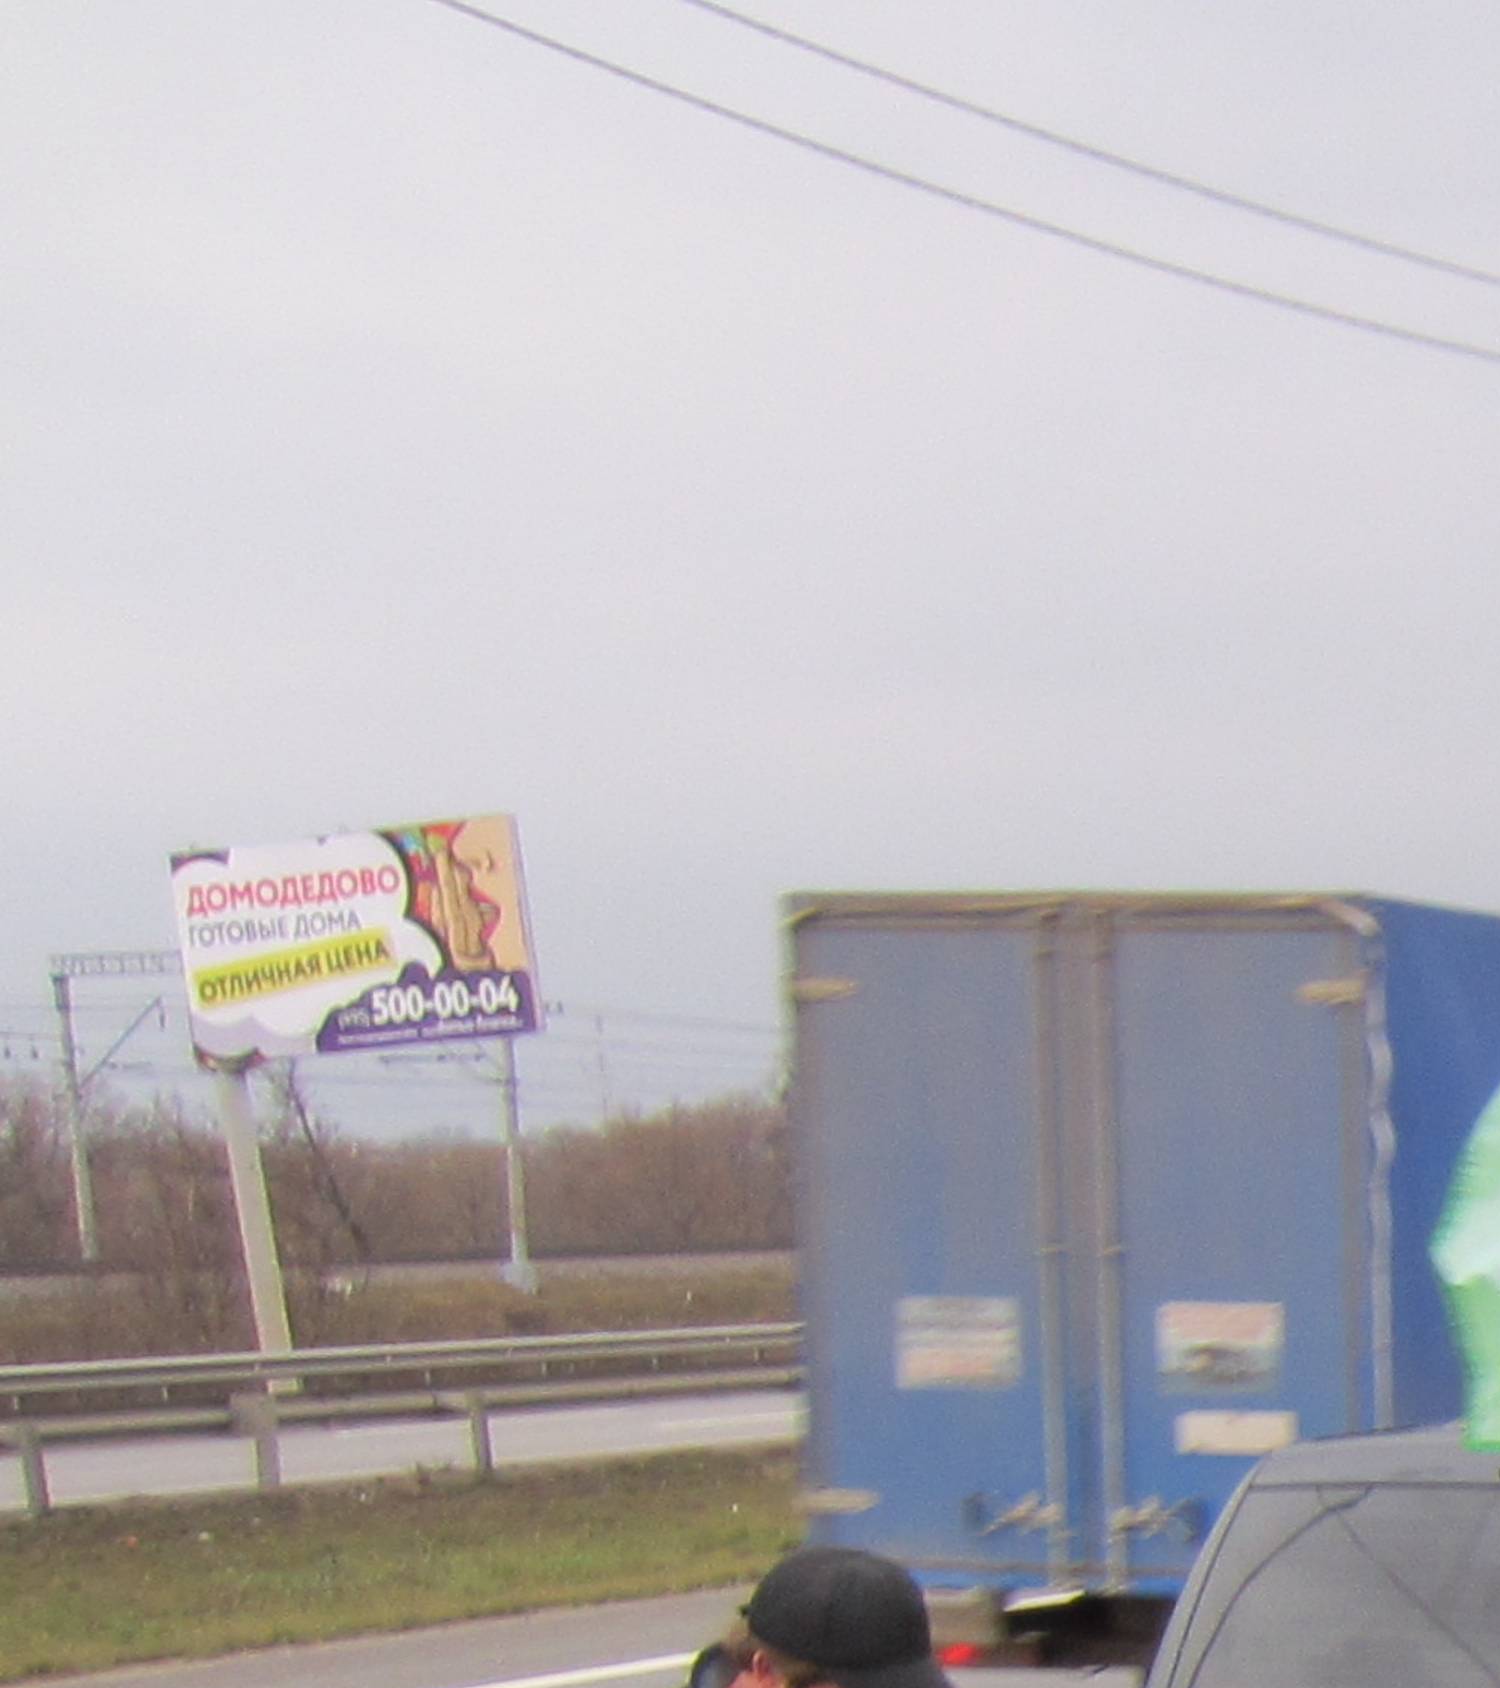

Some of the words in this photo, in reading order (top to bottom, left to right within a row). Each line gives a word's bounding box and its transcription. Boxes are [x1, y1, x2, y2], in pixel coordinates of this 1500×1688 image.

[187, 864, 400, 917] ДОМОДЕДОВО
[188, 918, 287, 948] ГОТОВЫЕ
[293, 908, 361, 941] ДОМА
[199, 951, 322, 1002] ОТЛИЧНАЯ
[325, 937, 389, 976] ЦЕНА
[372, 976, 519, 1025] 500-00-04
